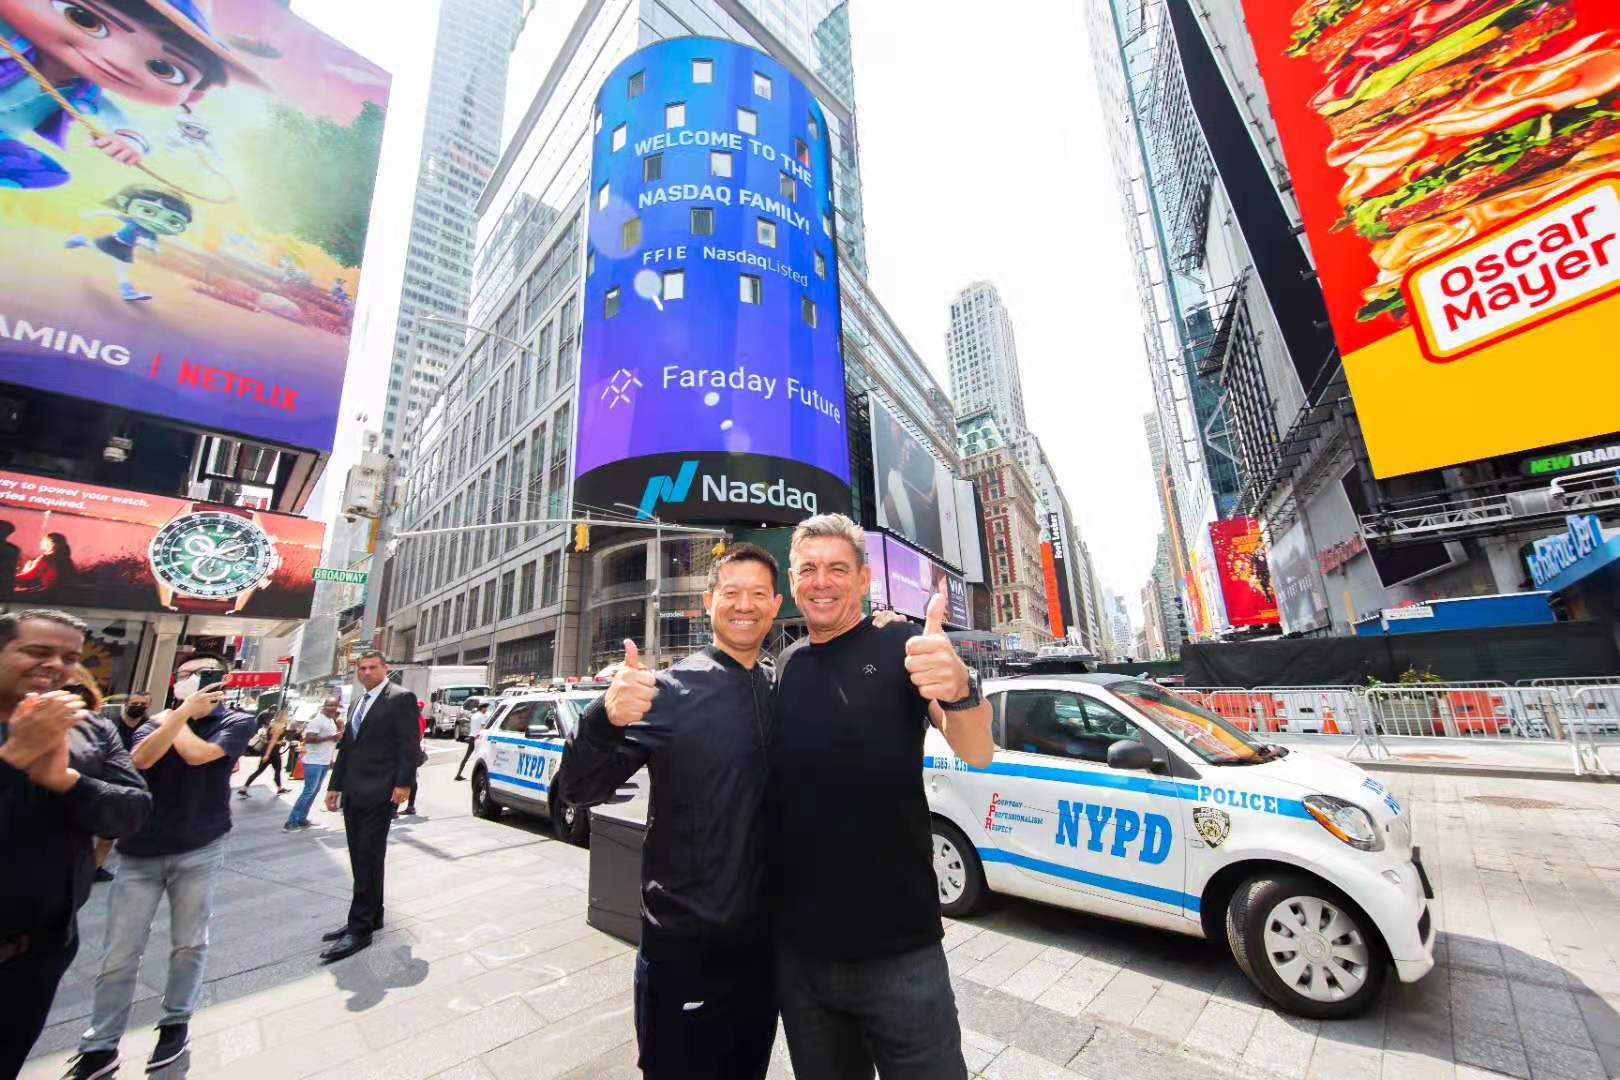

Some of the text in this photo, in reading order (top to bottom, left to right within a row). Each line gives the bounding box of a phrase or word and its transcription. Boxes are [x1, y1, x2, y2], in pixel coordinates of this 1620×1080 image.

[635, 130, 812, 188] WELCOME TO THE
[639, 184, 810, 235] NASDAQ FAMILY!
[642, 246, 687, 265] FFIE
[1443, 233, 1616, 331] Mayer
[177, 359, 299, 413] NETFLIX
[663, 365, 841, 424] Faraday Future
[0, 491, 26, 502] ries
[20, 481, 37, 490] to
[38, 485, 78, 497] power
[81, 490, 110, 501] your
[702, 475, 817, 515] Nasdaq
[314, 570, 366, 583] BROADWAY
[517, 752, 545, 779] NYPD
[1200, 786, 1277, 813] POLICE
[1055, 800, 1173, 865] NYPD
